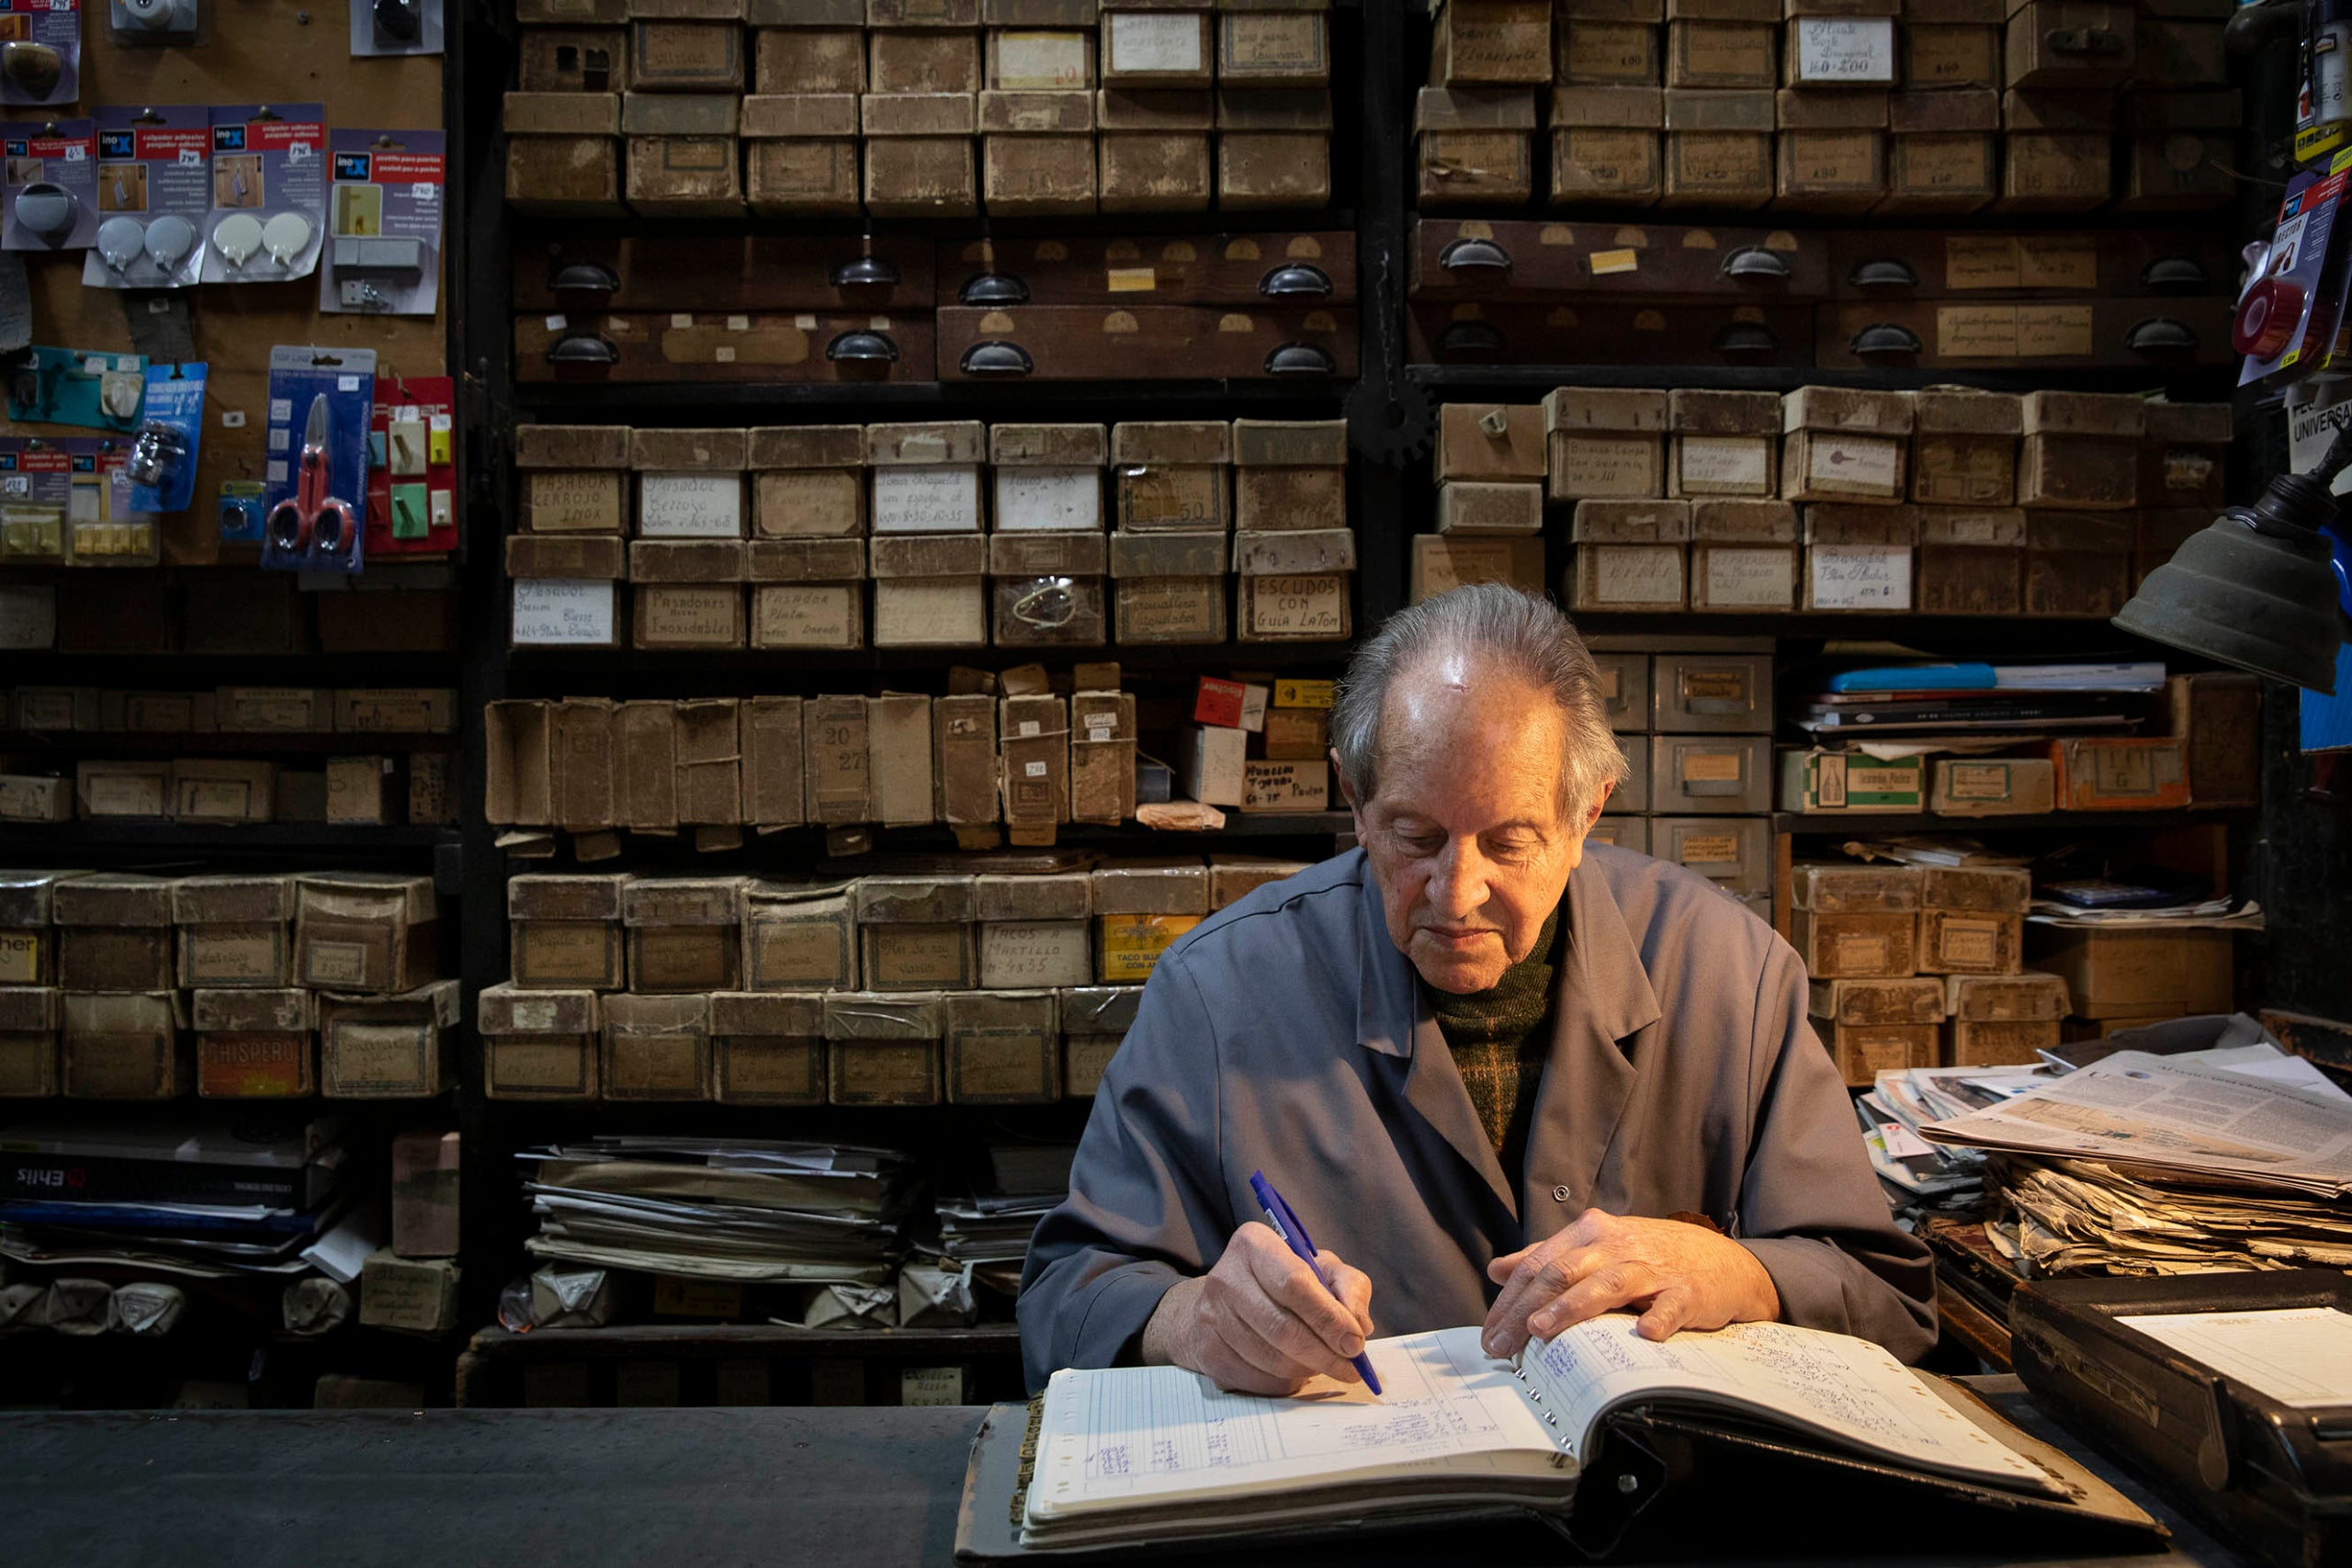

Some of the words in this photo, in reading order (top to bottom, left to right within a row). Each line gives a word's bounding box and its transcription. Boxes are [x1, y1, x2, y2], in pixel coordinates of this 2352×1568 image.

[1258, 579, 1336, 596] ESCUDOS
[825, 727, 851, 746] 20
[838, 751, 864, 771] 27
[1125, 962, 1145, 970] CON
[17, 1168, 65, 1187] Ehlis
